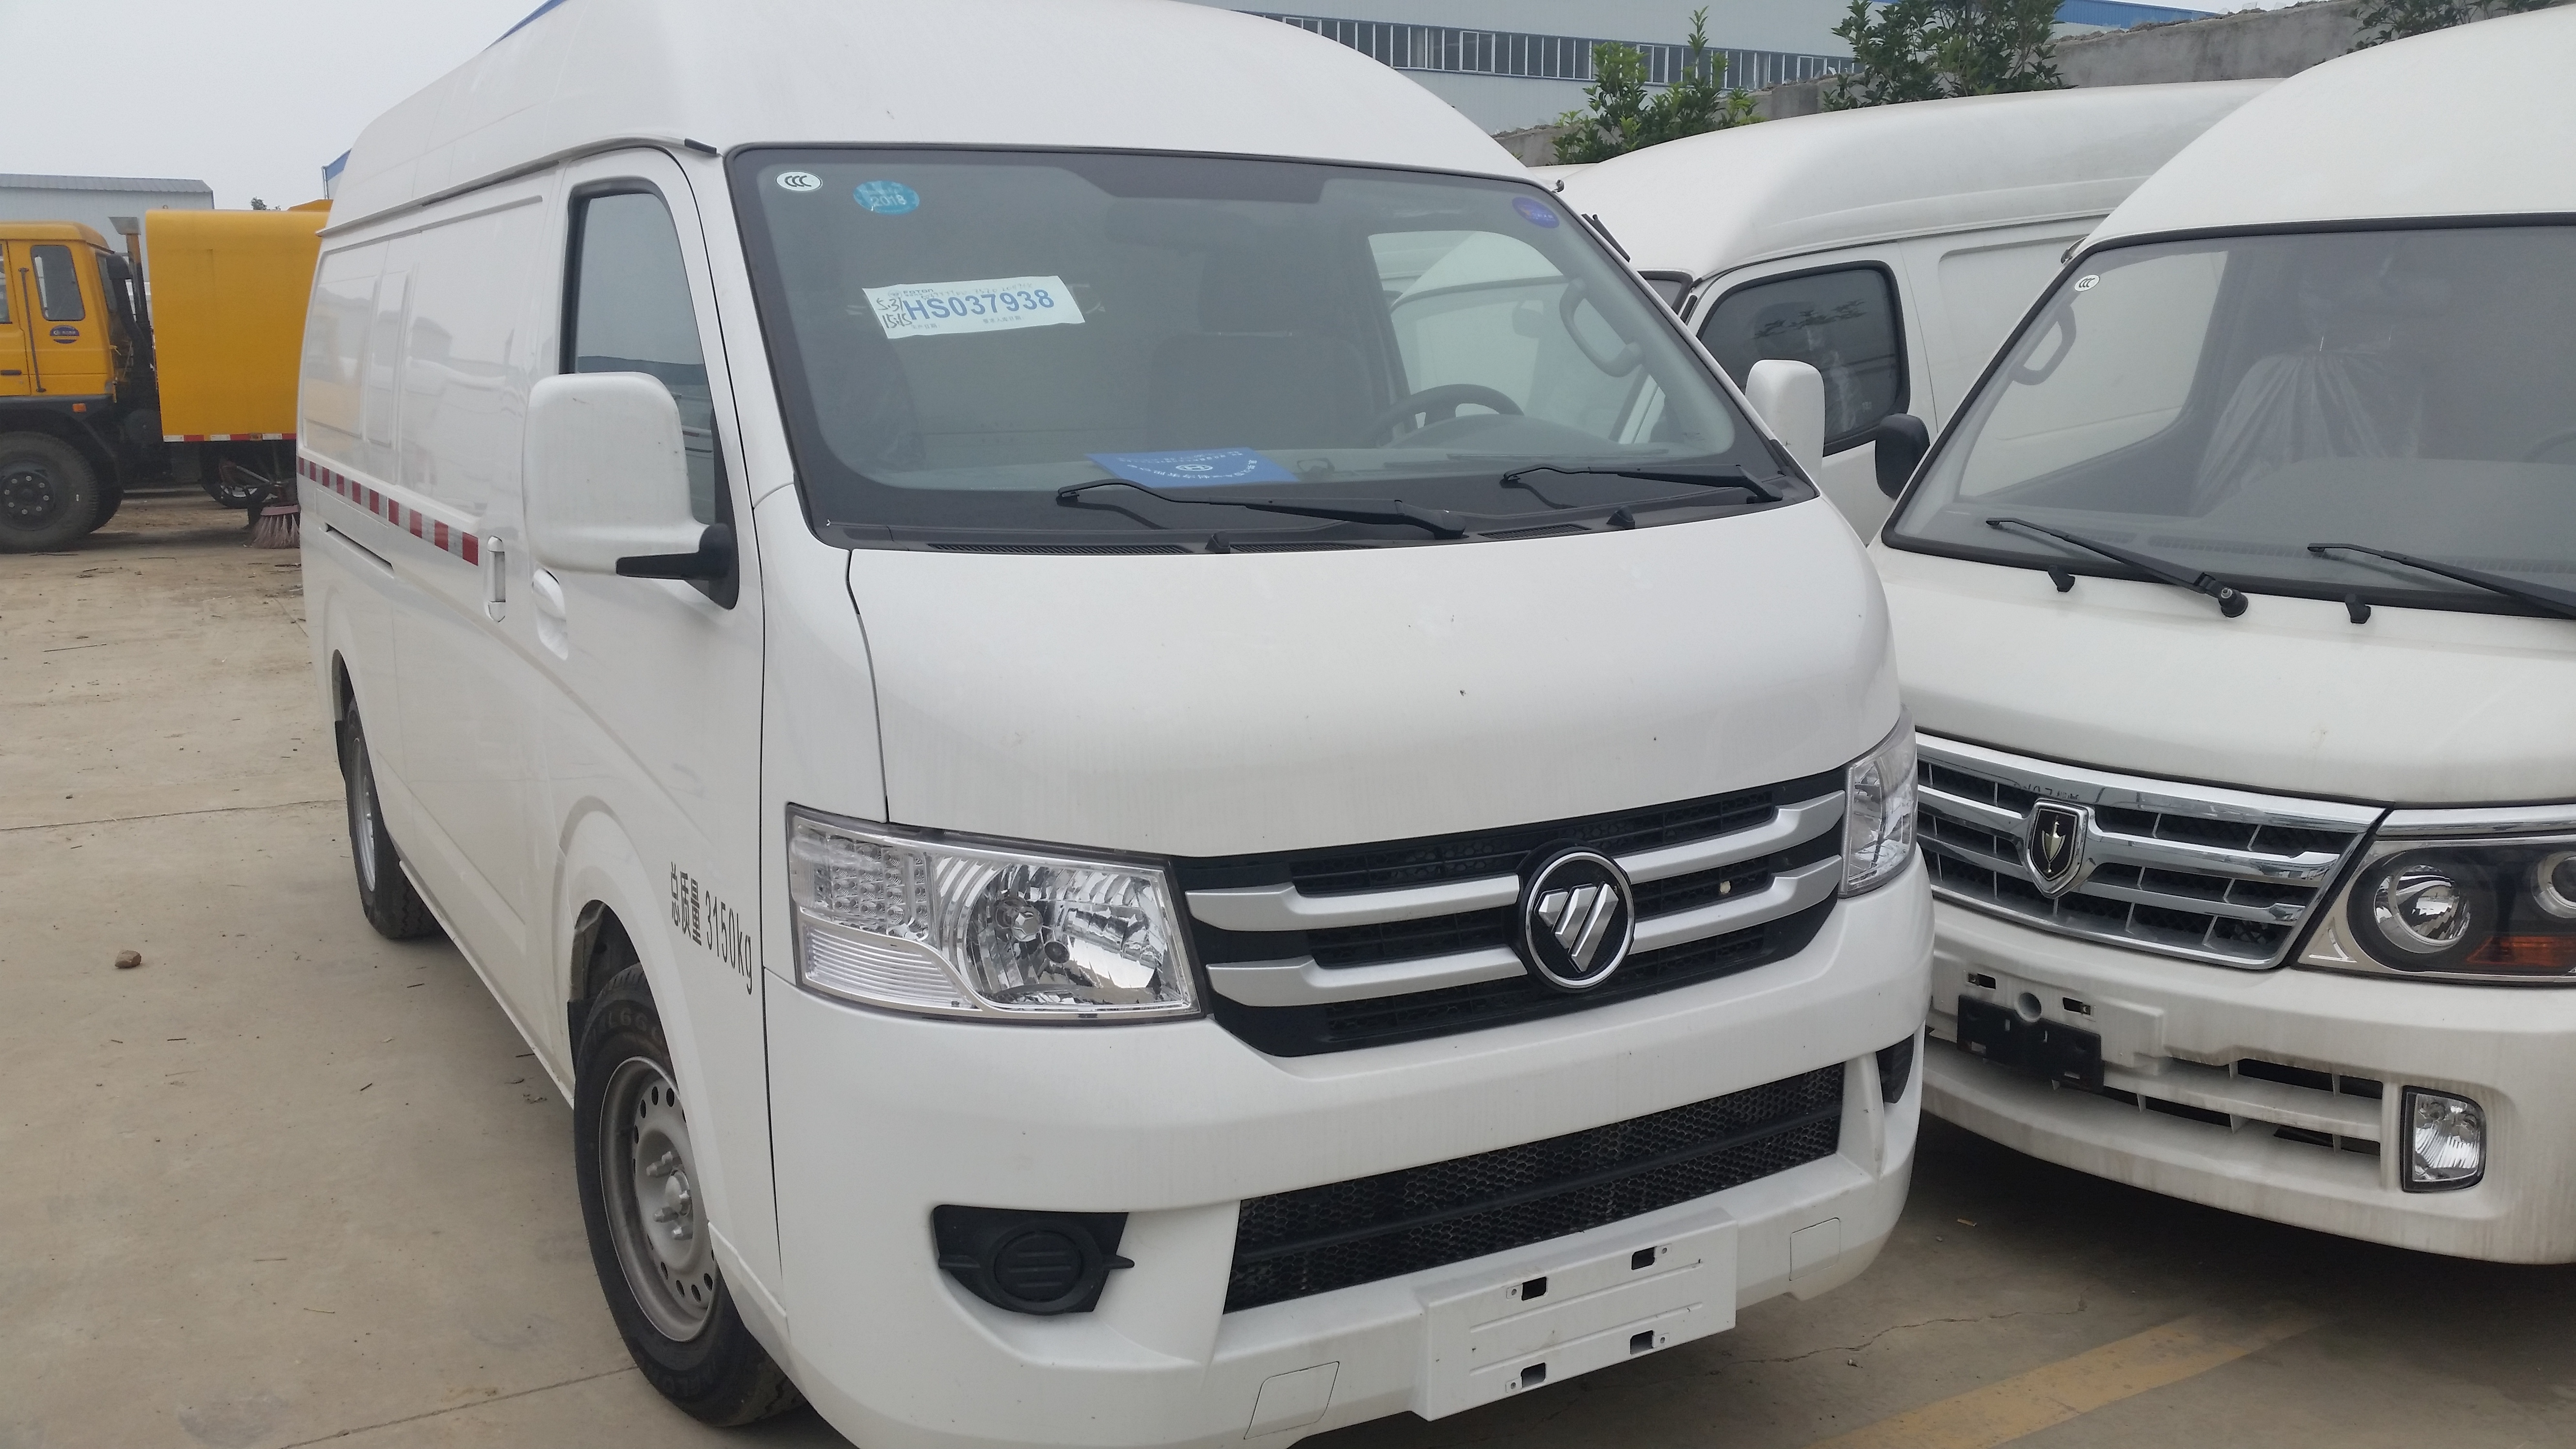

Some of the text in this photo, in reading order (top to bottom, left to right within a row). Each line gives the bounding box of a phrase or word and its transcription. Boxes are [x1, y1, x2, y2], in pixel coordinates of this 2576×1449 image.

[870, 194, 907, 207] 2018
[902, 289, 1054, 320] HS037938
[671, 861, 753, 995] 总质量 3150kg
